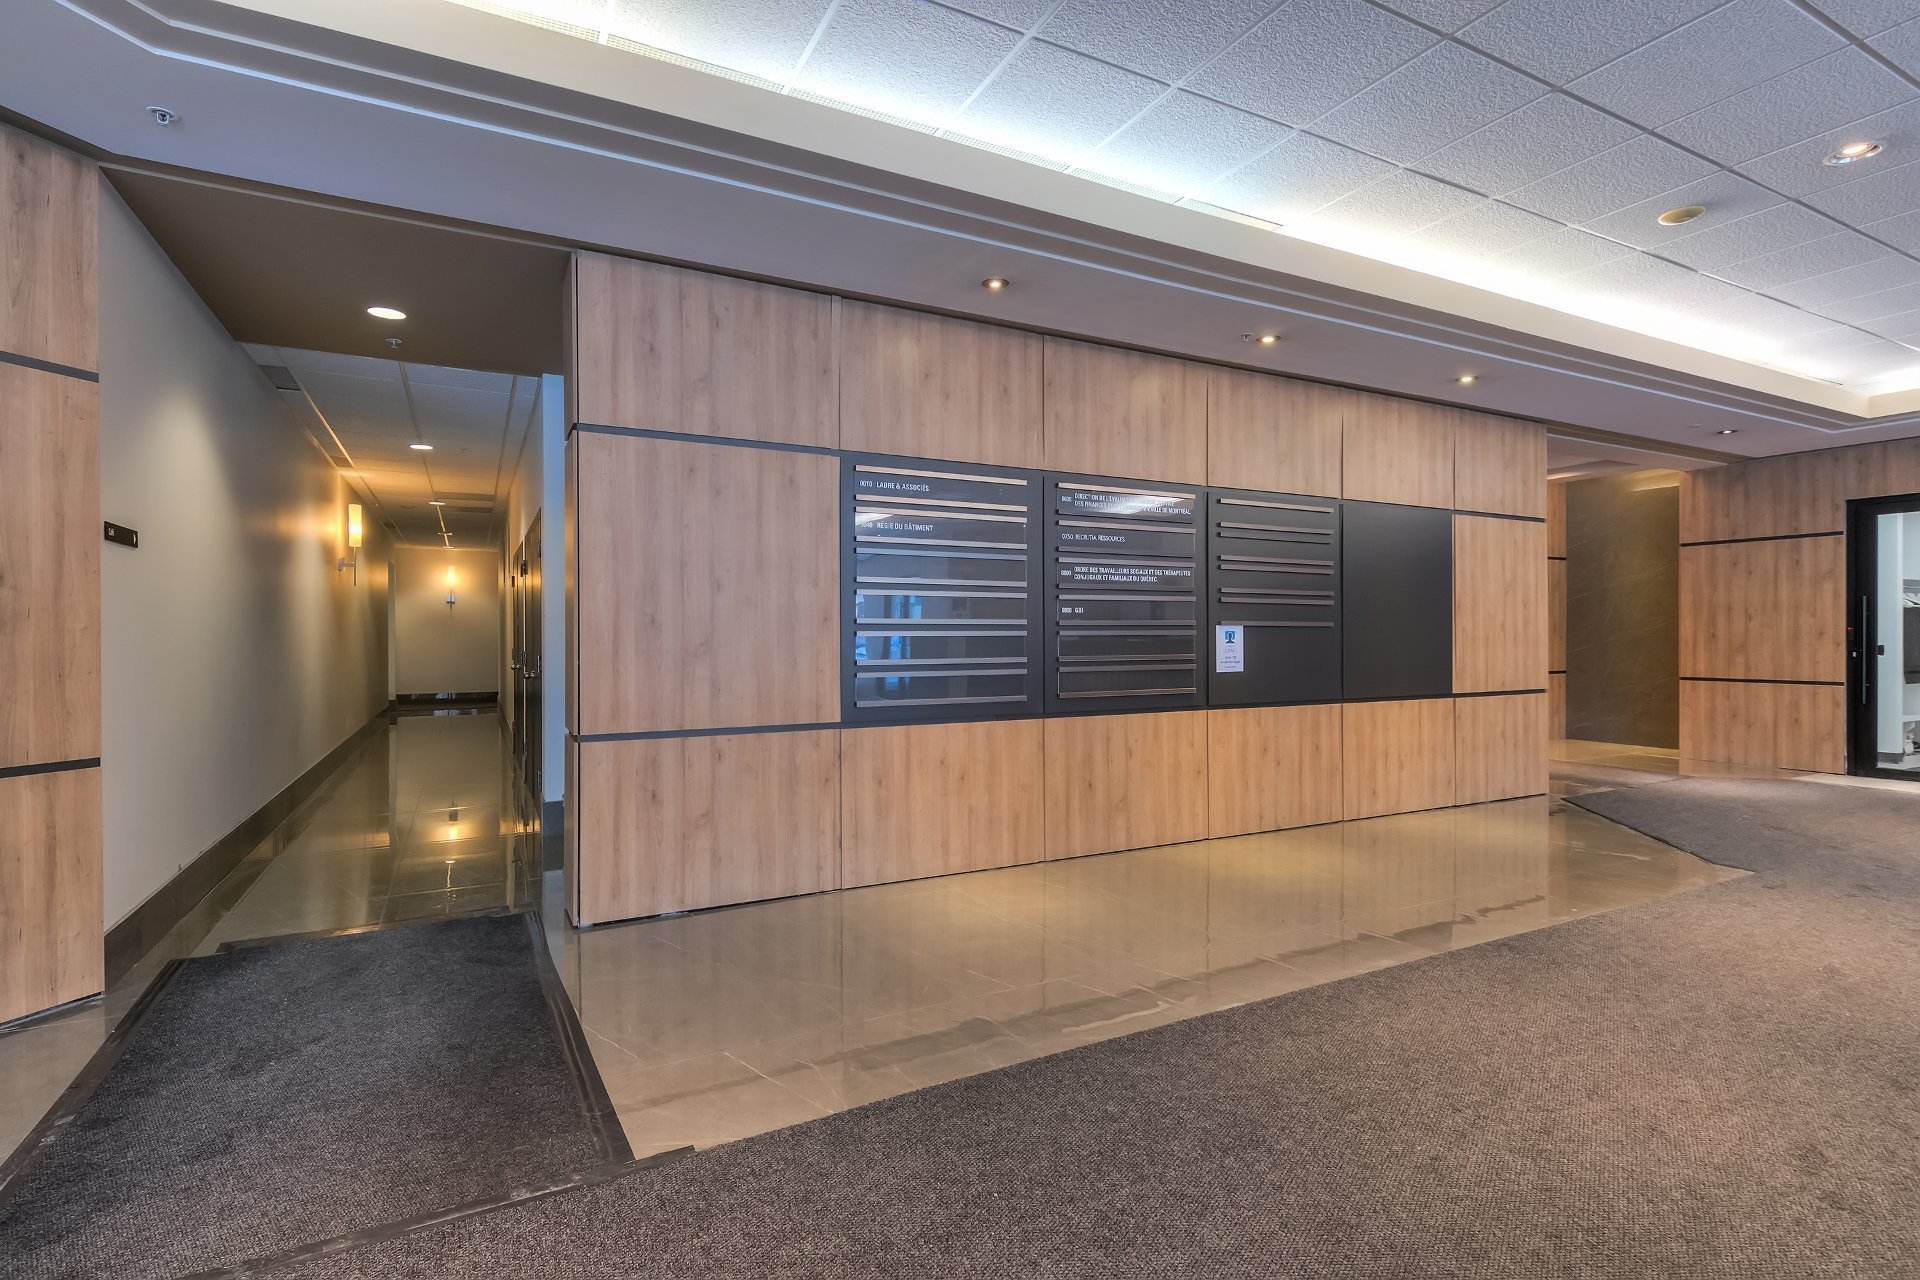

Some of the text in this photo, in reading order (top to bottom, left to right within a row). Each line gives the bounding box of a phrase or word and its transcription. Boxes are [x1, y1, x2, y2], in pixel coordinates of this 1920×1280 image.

[902, 484, 930, 492] ASSOCIÉS
[876, 521, 894, 529] RÉGIE
[904, 523, 933, 532] BÂTIMENT
[1098, 534, 1126, 543] RESSOURCES
